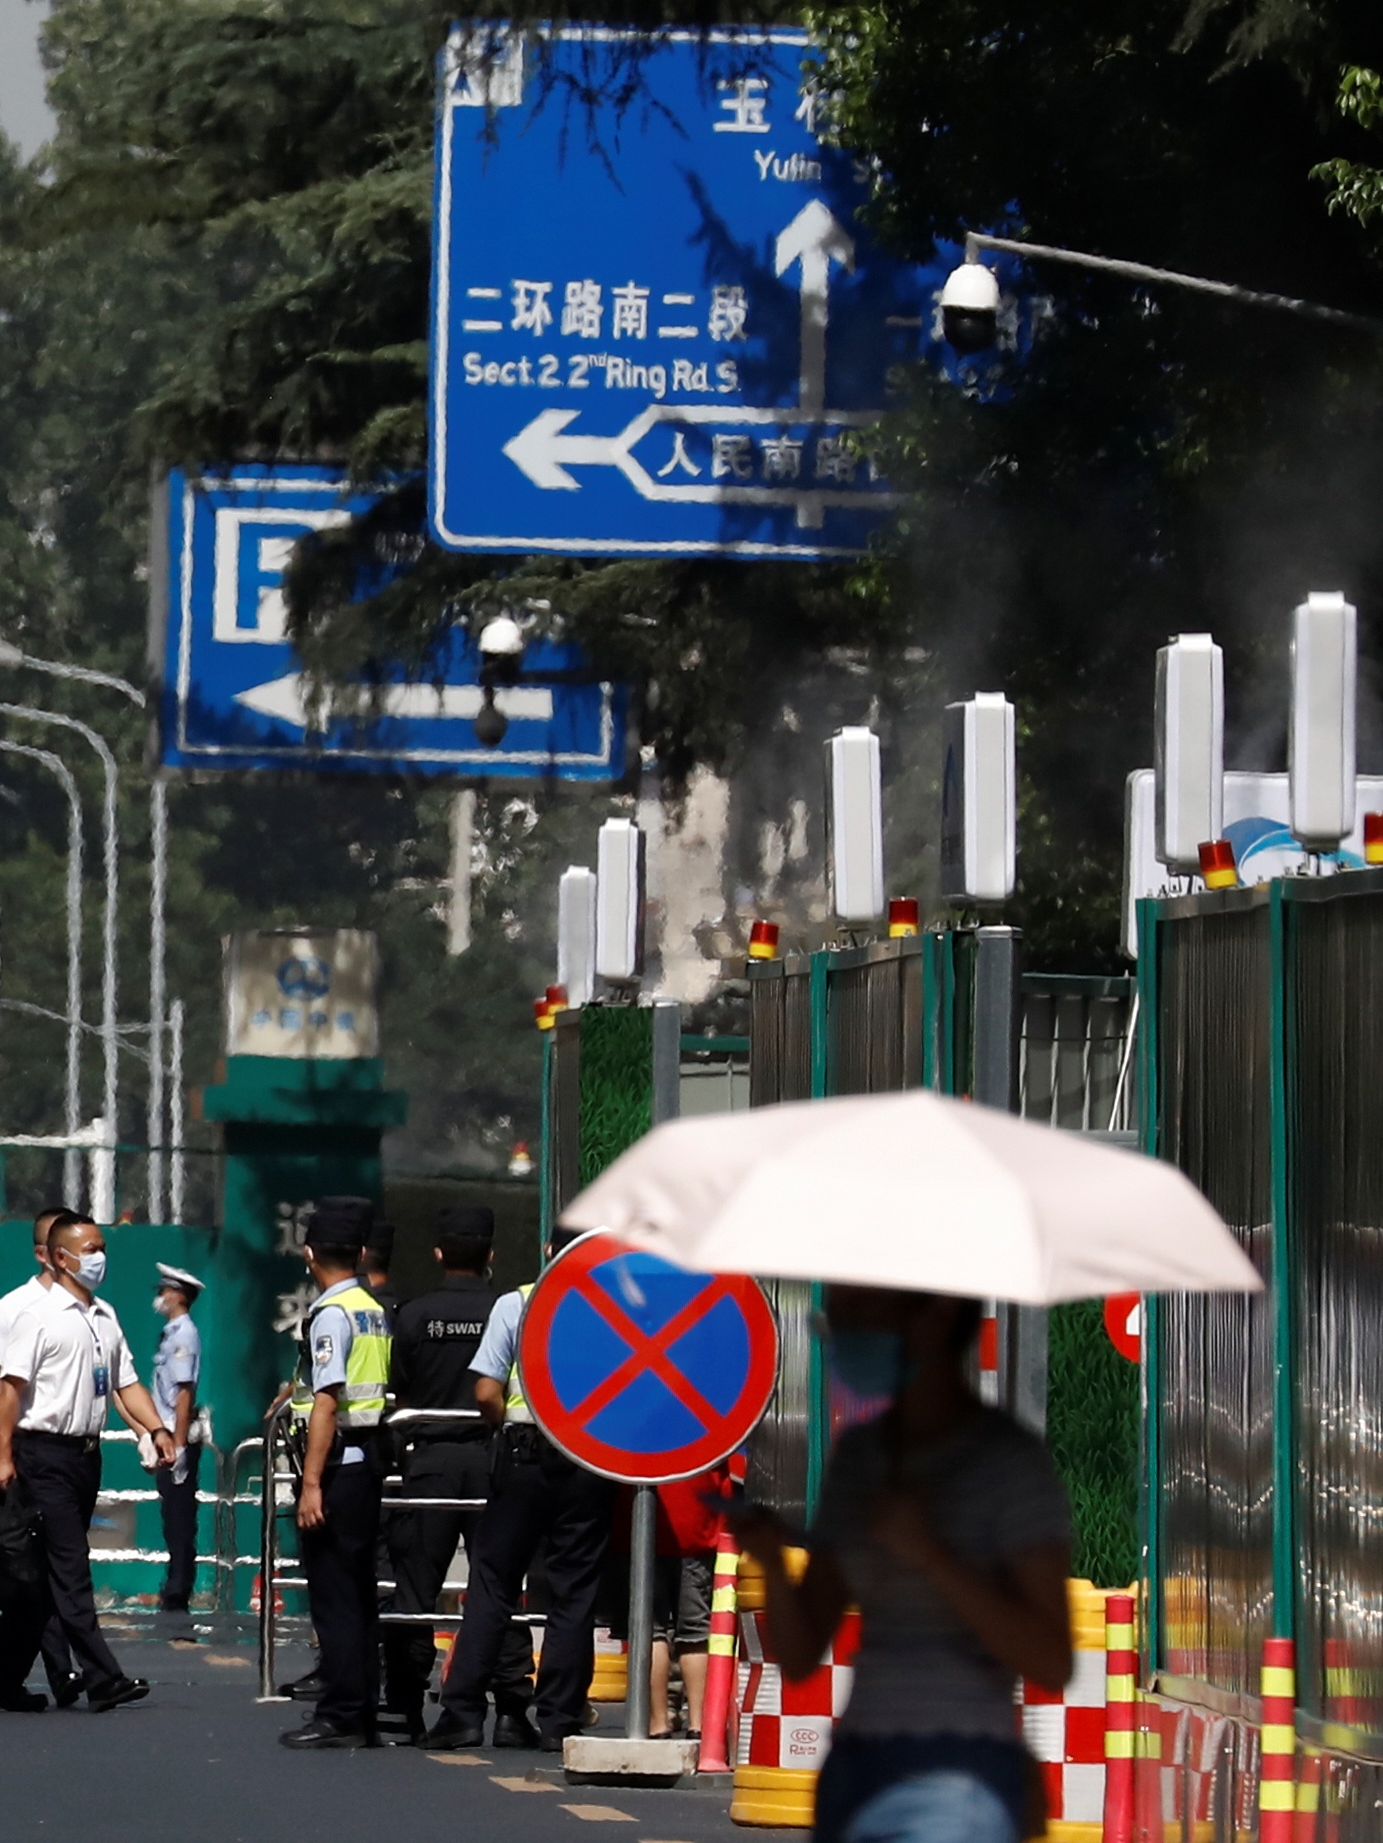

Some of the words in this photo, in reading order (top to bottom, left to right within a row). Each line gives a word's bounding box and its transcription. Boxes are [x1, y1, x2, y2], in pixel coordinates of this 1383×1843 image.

[462, 278, 749, 342] 二环路南二段
[605, 355, 667, 400] Ring
[446, 1322, 483, 1335] SWAT
